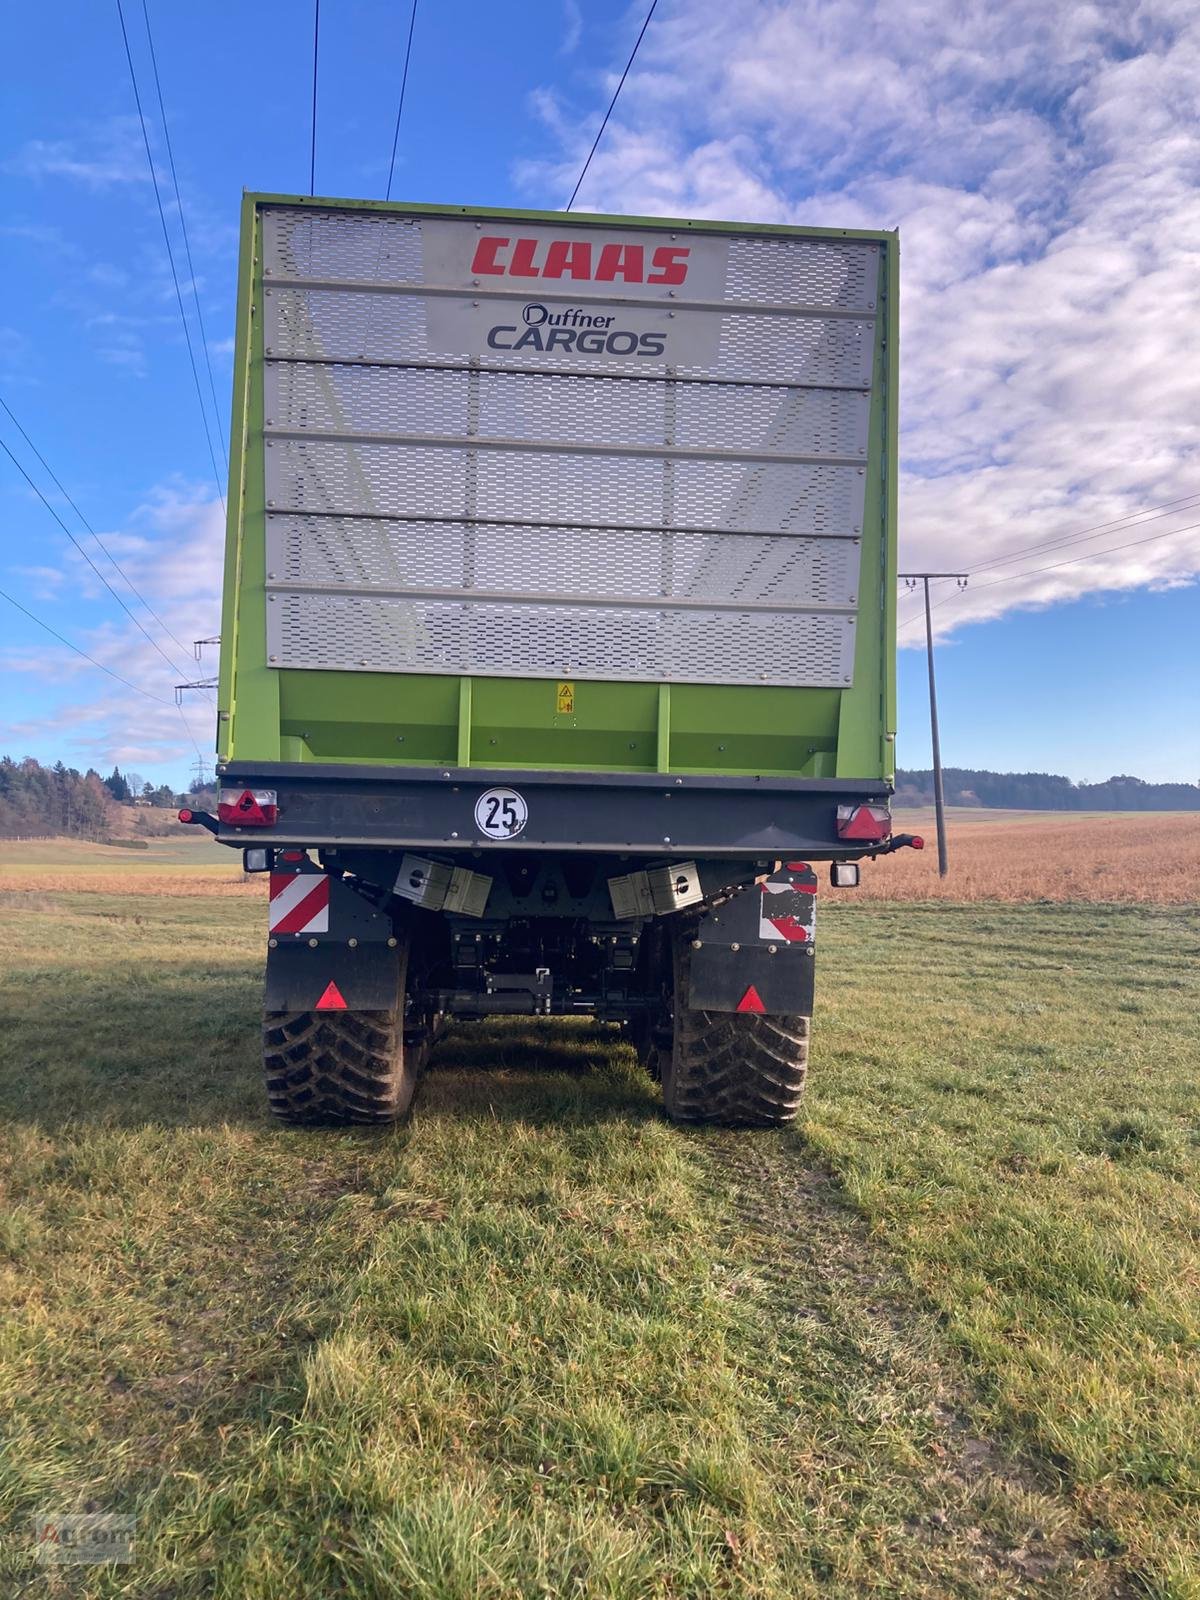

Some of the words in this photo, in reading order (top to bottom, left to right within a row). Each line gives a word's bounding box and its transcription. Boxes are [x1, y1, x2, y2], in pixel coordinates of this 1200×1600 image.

[471, 237, 691, 285] CLAAS
[522, 303, 615, 328] Duffner
[487, 326, 667, 356] CARGOS
[486, 797, 516, 829] 25
